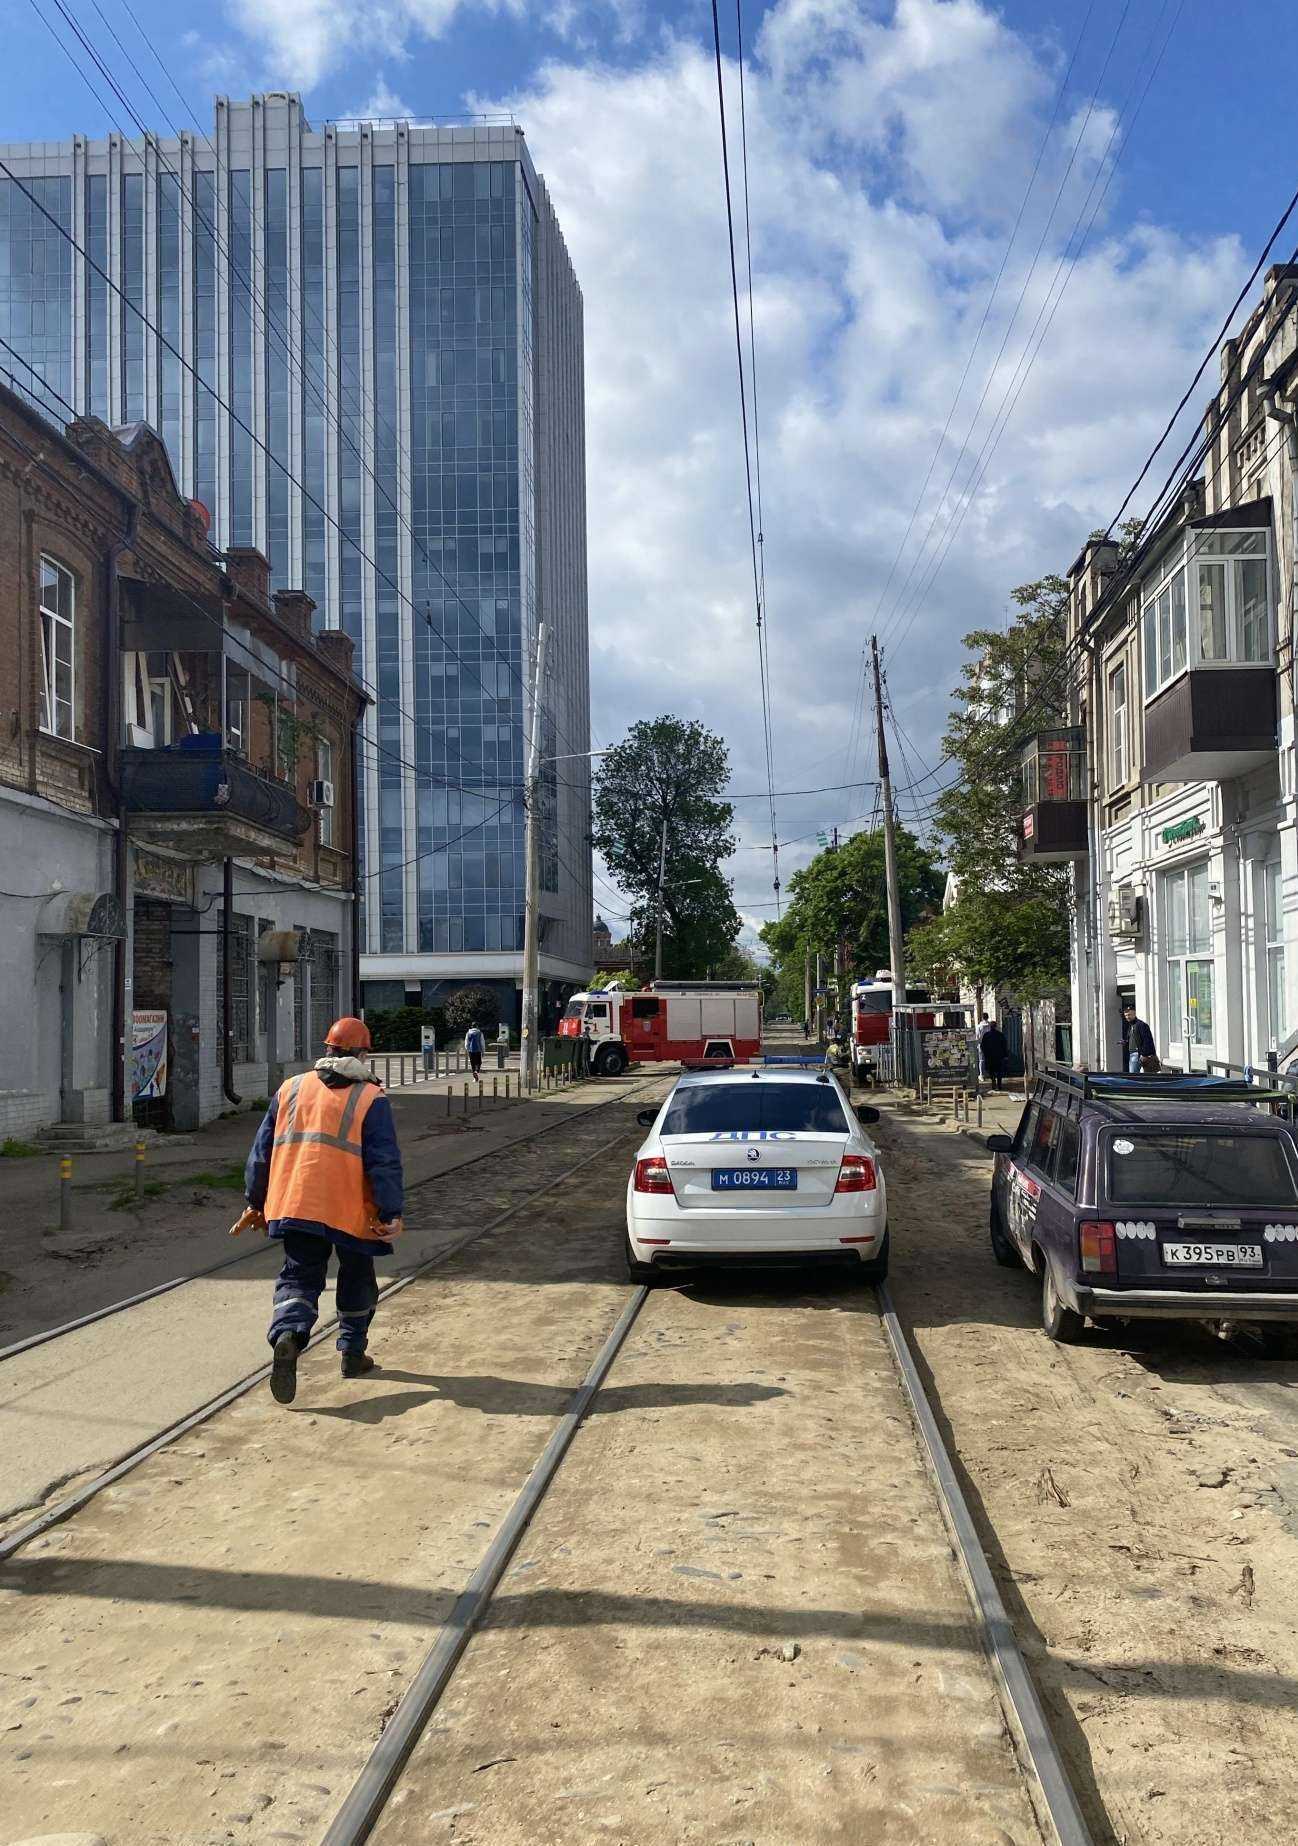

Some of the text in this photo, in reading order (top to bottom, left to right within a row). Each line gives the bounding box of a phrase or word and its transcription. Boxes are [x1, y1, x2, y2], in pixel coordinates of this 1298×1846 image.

[709, 1131, 797, 1141] ДПС
[734, 1171, 768, 1184] 0894
[777, 1171, 791, 1180] 23
[1239, 1246, 1256, 1258] 93
